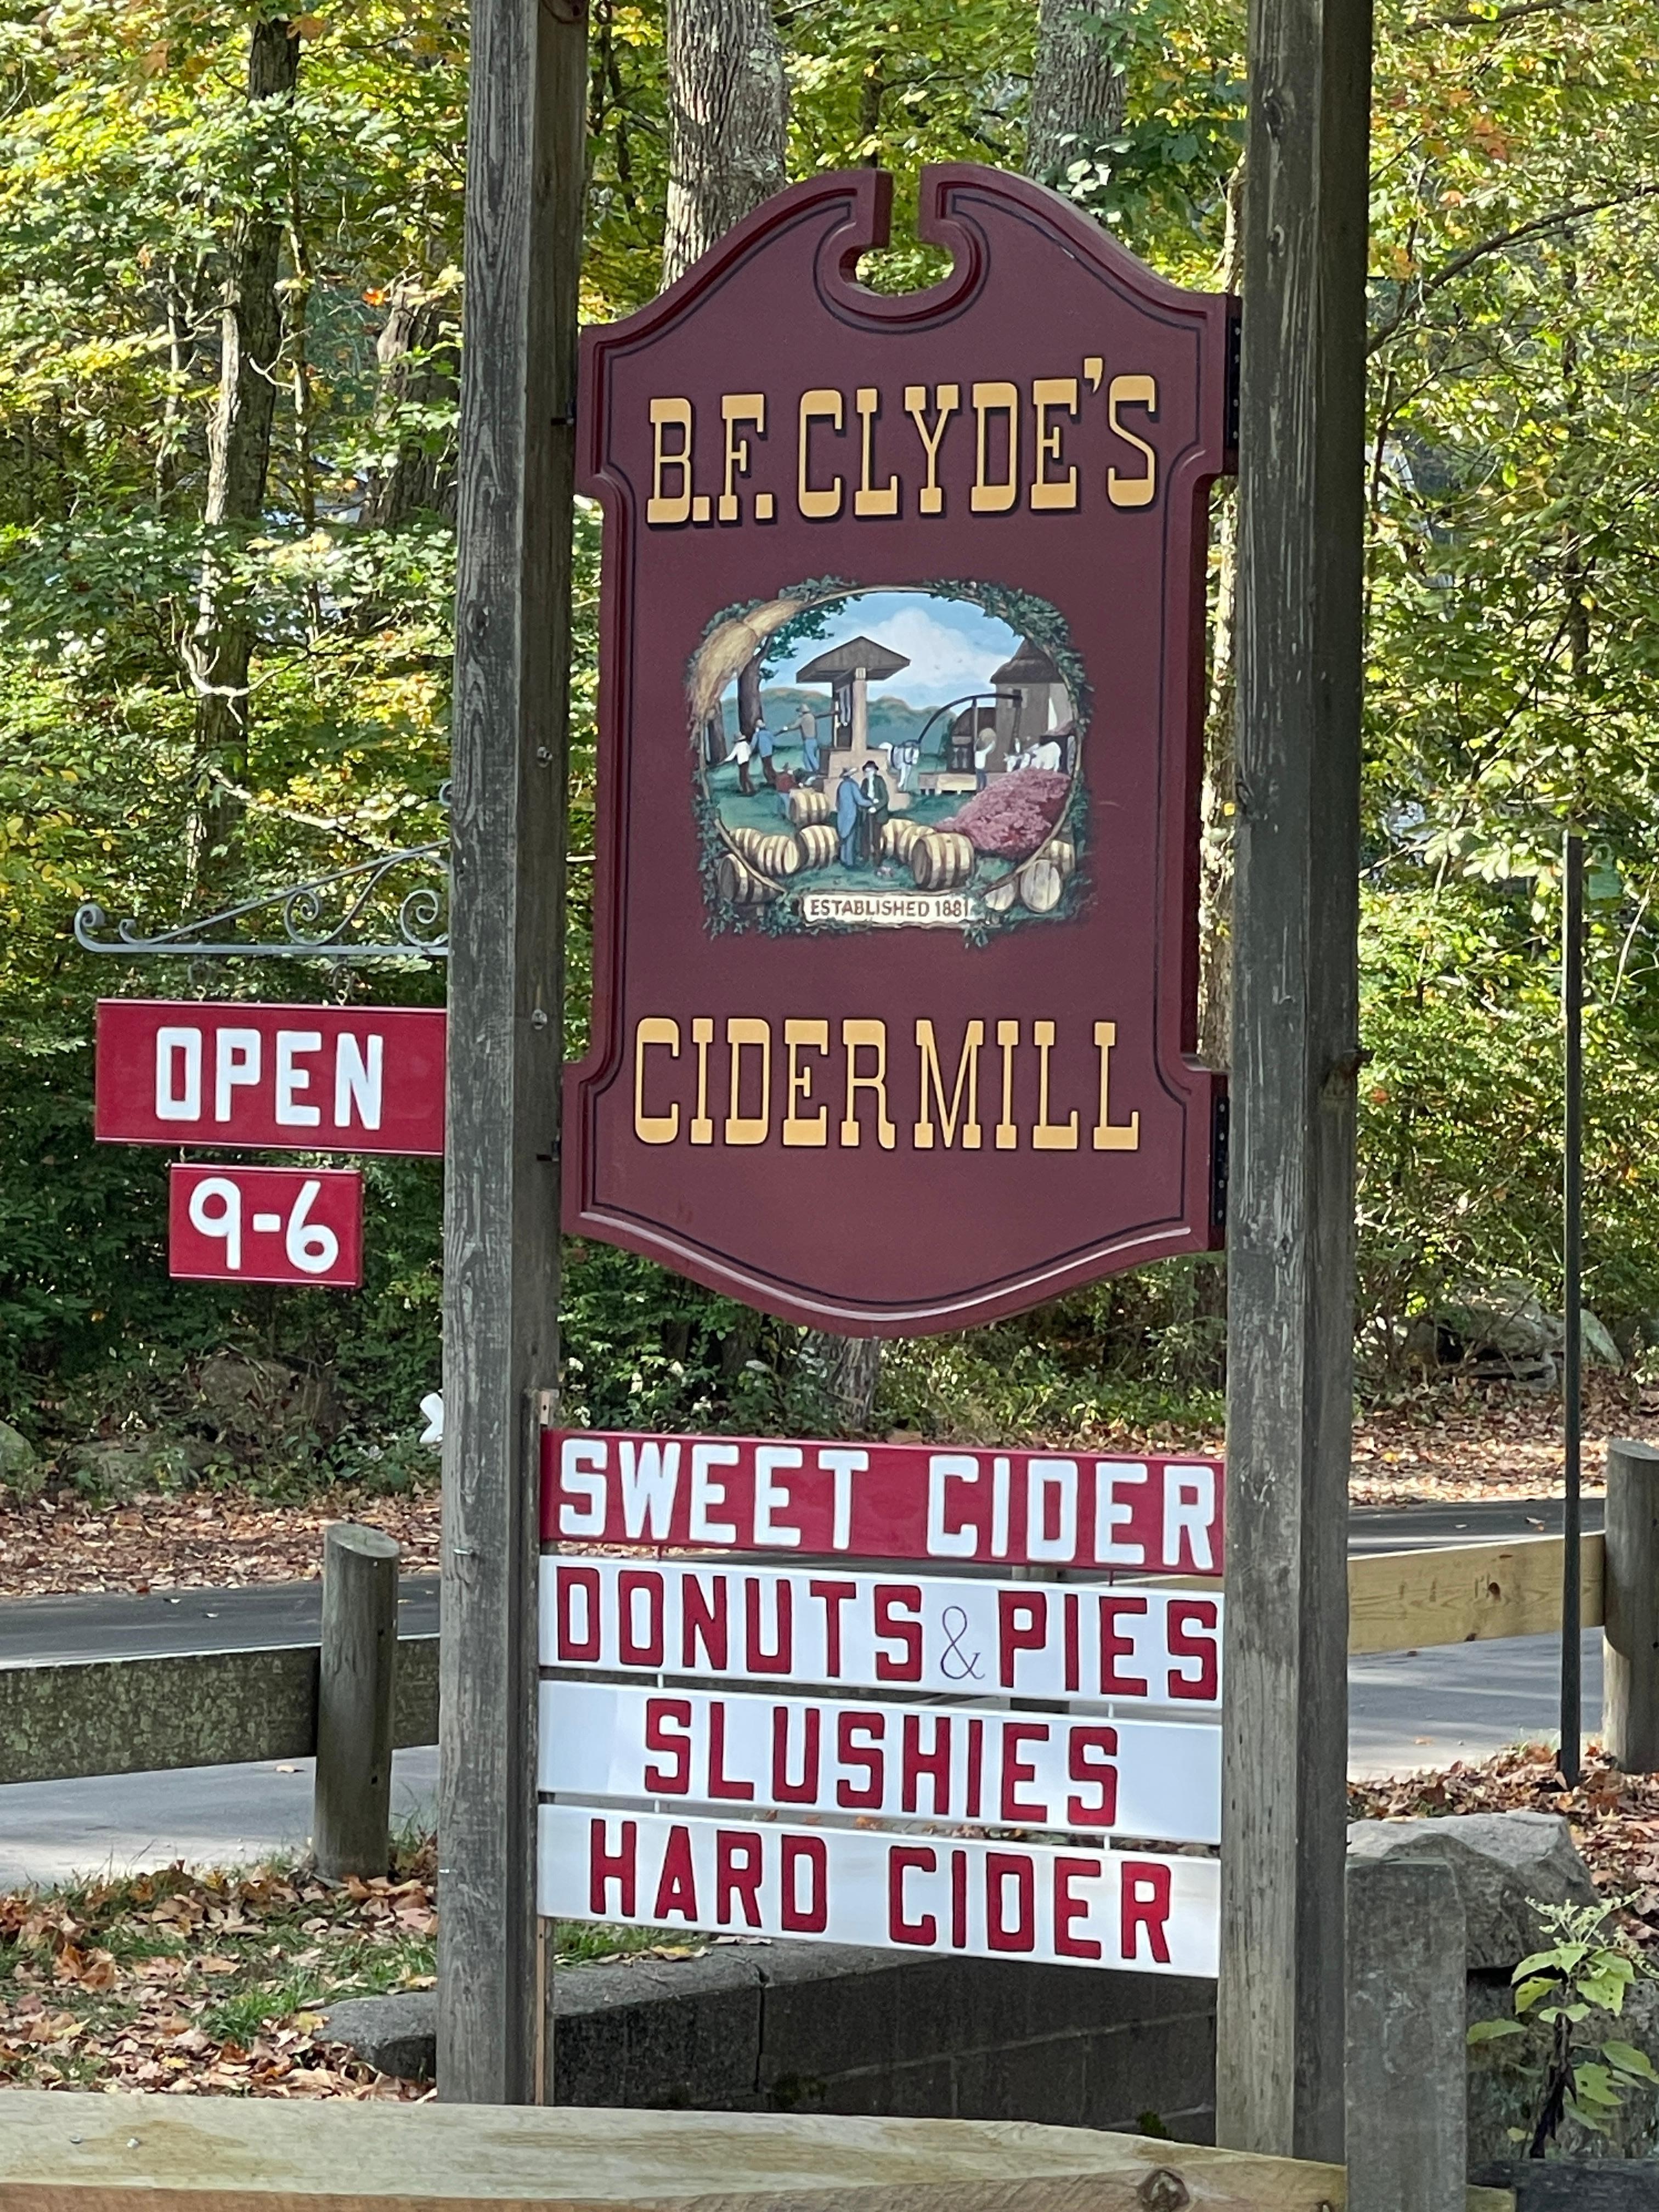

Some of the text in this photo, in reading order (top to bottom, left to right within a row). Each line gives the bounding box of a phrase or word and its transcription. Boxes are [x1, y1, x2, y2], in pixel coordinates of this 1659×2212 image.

[647, 358, 1156, 523] B.F. CLYDE'S
[810, 898, 969, 917] ESTABLISHED 1881
[155, 1027, 383, 1130] OPEN
[635, 1018, 1139, 1150] CIDER MILL
[188, 1177, 339, 1274] 9-6
[558, 1438, 1215, 1570] SWEET CIDER
[556, 1566, 1217, 1701] DONUTS & PIES
[644, 1697, 1119, 1827] SLUSHIES
[589, 1818, 1172, 1963] HARD CIDER
